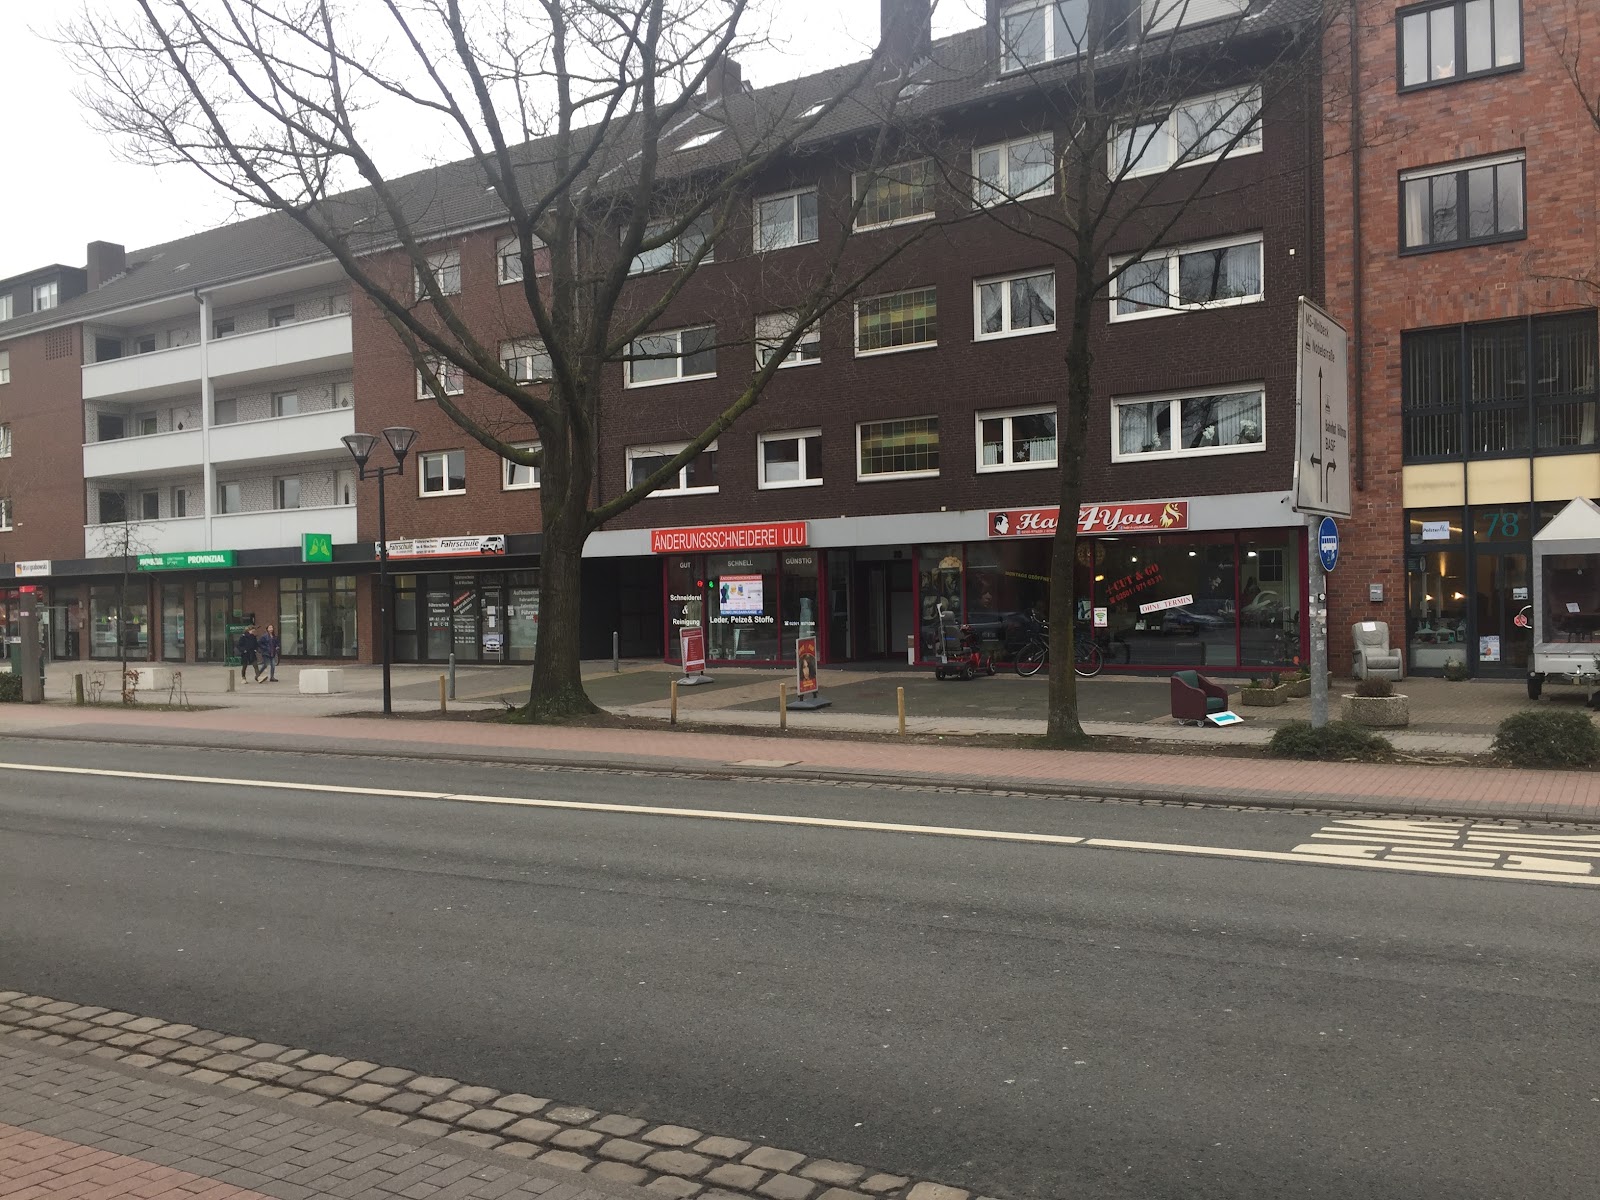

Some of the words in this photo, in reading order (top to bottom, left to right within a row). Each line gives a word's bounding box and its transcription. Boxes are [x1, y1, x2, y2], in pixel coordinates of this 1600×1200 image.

[1325, 437, 1336, 451] BASF
[1483, 512, 1519, 537] 78
[440, 539, 480, 548] Fahrschule
[654, 529, 778, 550] ÄNDERUNGSSCHNEIDEREI
[783, 527, 803, 545] ULU
[389, 541, 413, 552] Fahrschule
[187, 555, 225, 564] PROVINZIAL
[785, 557, 812, 565] GÜNSTIG
[1144, 563, 1159, 576] GO
[682, 605, 688, 614] &
[1142, 602, 1162, 613] OHNE
[1164, 597, 1191, 609] TERMIN
[672, 618, 700, 626] Reinigung
[709, 615, 729, 625] Leder,
[754, 615, 774, 624] Stoffe
